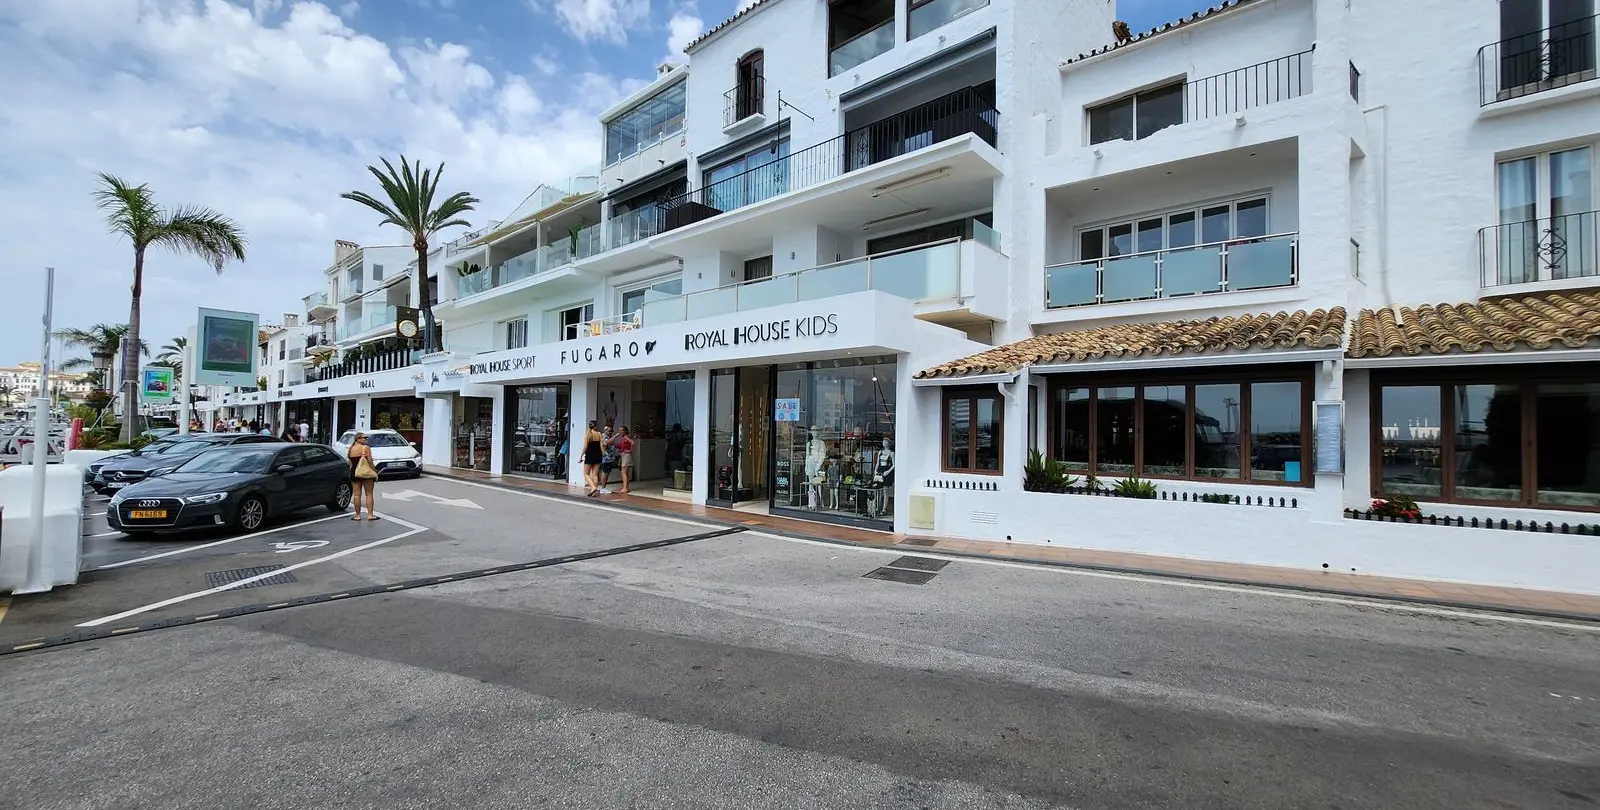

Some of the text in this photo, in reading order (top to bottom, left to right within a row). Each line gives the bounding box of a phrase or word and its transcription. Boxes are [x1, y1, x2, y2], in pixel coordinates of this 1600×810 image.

[684, 313, 838, 351] ROYAL HOUSE KIDS
[560, 341, 639, 365] FUGARO
[470, 356, 537, 375] ROYAL HOUSE SPORT
[776, 402, 797, 410] SALE
